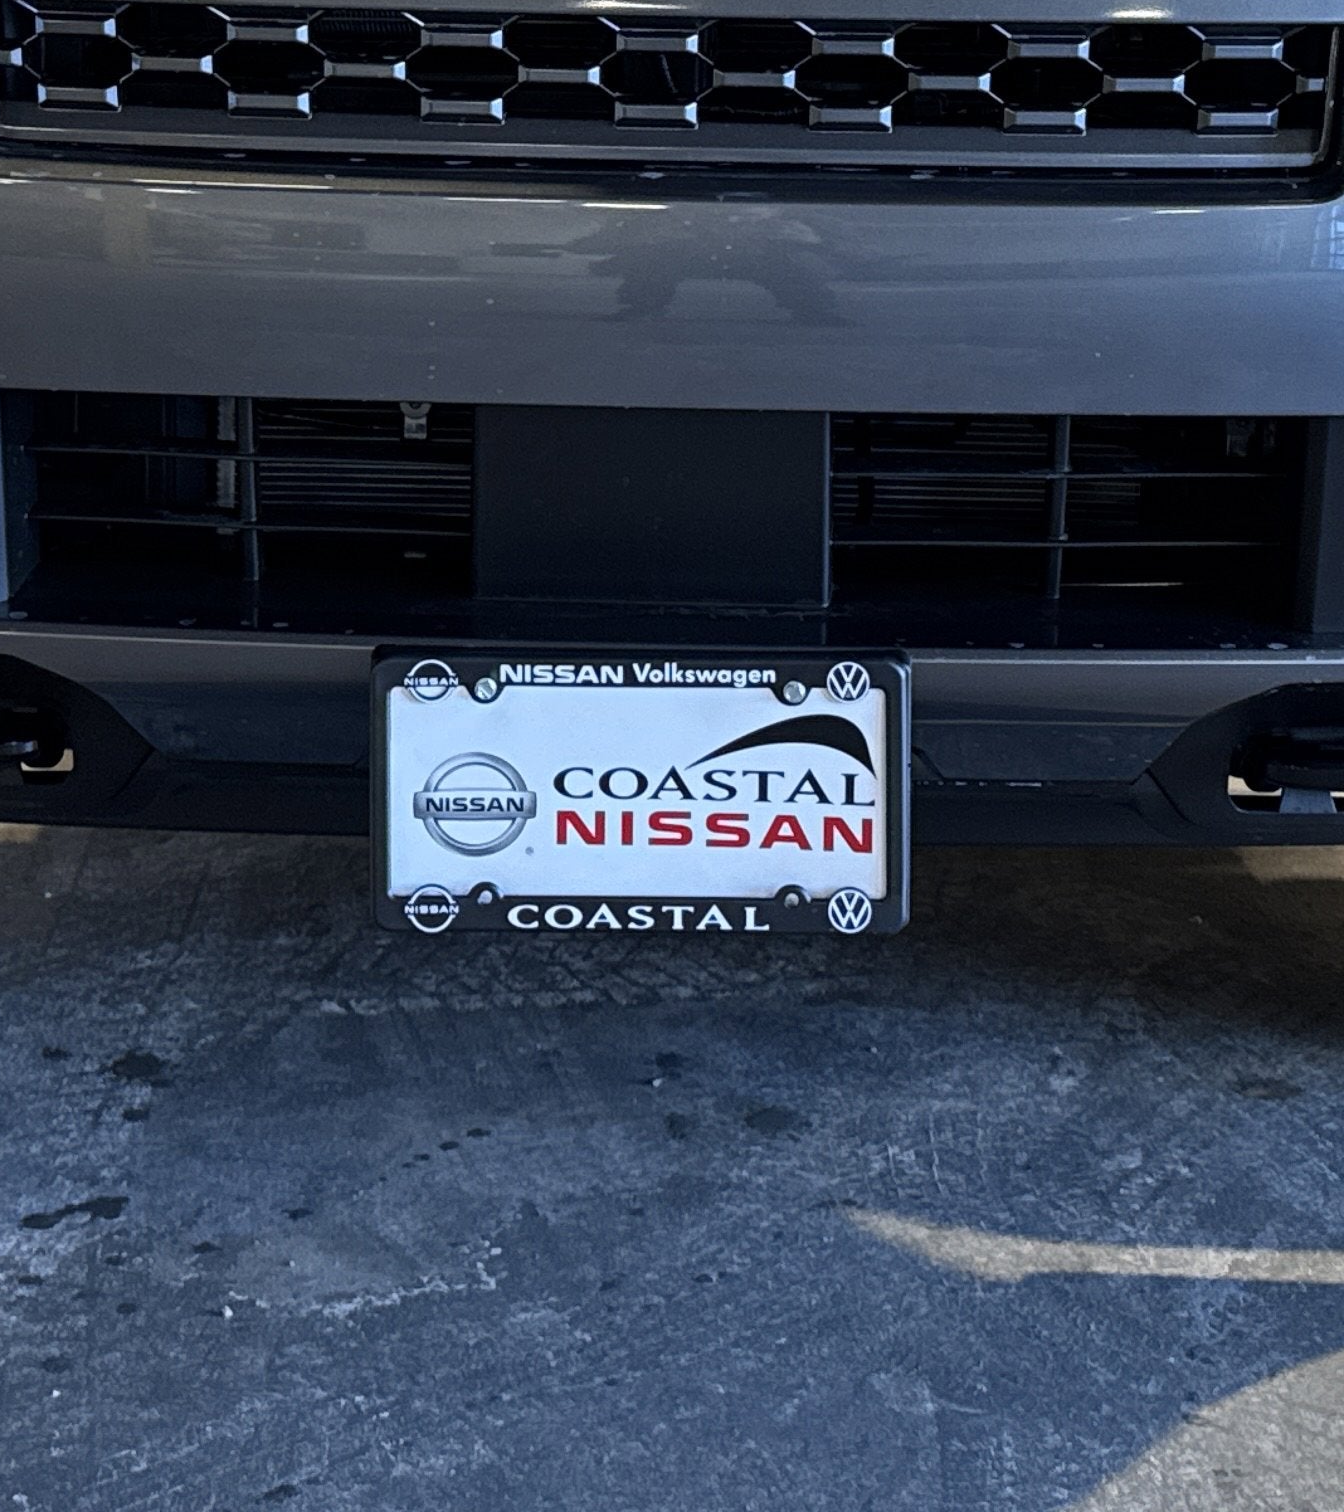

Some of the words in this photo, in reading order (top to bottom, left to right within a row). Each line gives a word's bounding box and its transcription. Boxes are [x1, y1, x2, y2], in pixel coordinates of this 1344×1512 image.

[403, 675, 459, 686] NISSAN
[499, 663, 624, 685] NISSAN
[632, 662, 777, 687] Volkswagen
[553, 766, 876, 807] COASTAL
[425, 796, 525, 813] NISSAN
[556, 810, 872, 853] NISSAN
[403, 904, 459, 916] NISSAN
[507, 904, 770, 931] COASTAL
